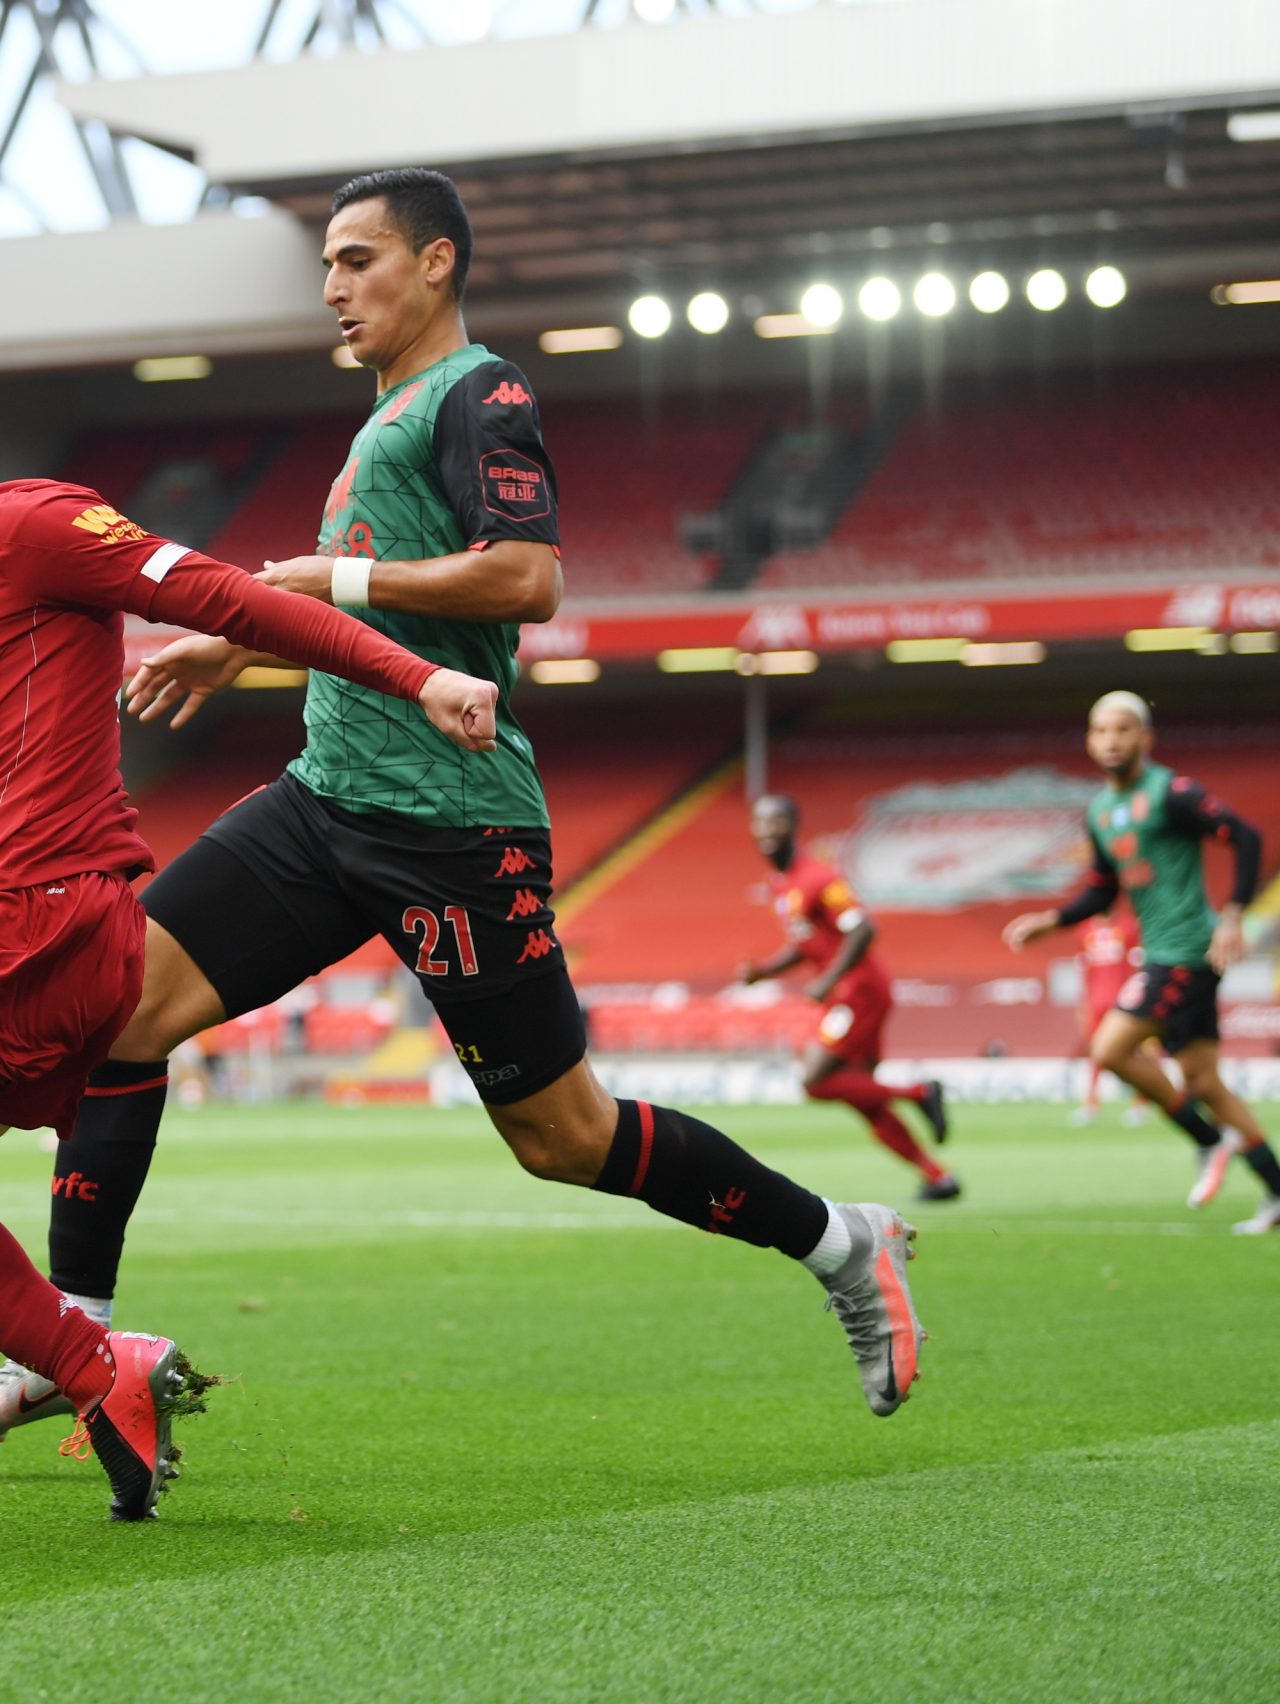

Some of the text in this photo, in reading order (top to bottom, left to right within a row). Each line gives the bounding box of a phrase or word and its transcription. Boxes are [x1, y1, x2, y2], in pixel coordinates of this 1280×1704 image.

[402, 905, 479, 976] 21
[454, 1042, 484, 1063] 21
[51, 1171, 99, 1201] vfc
